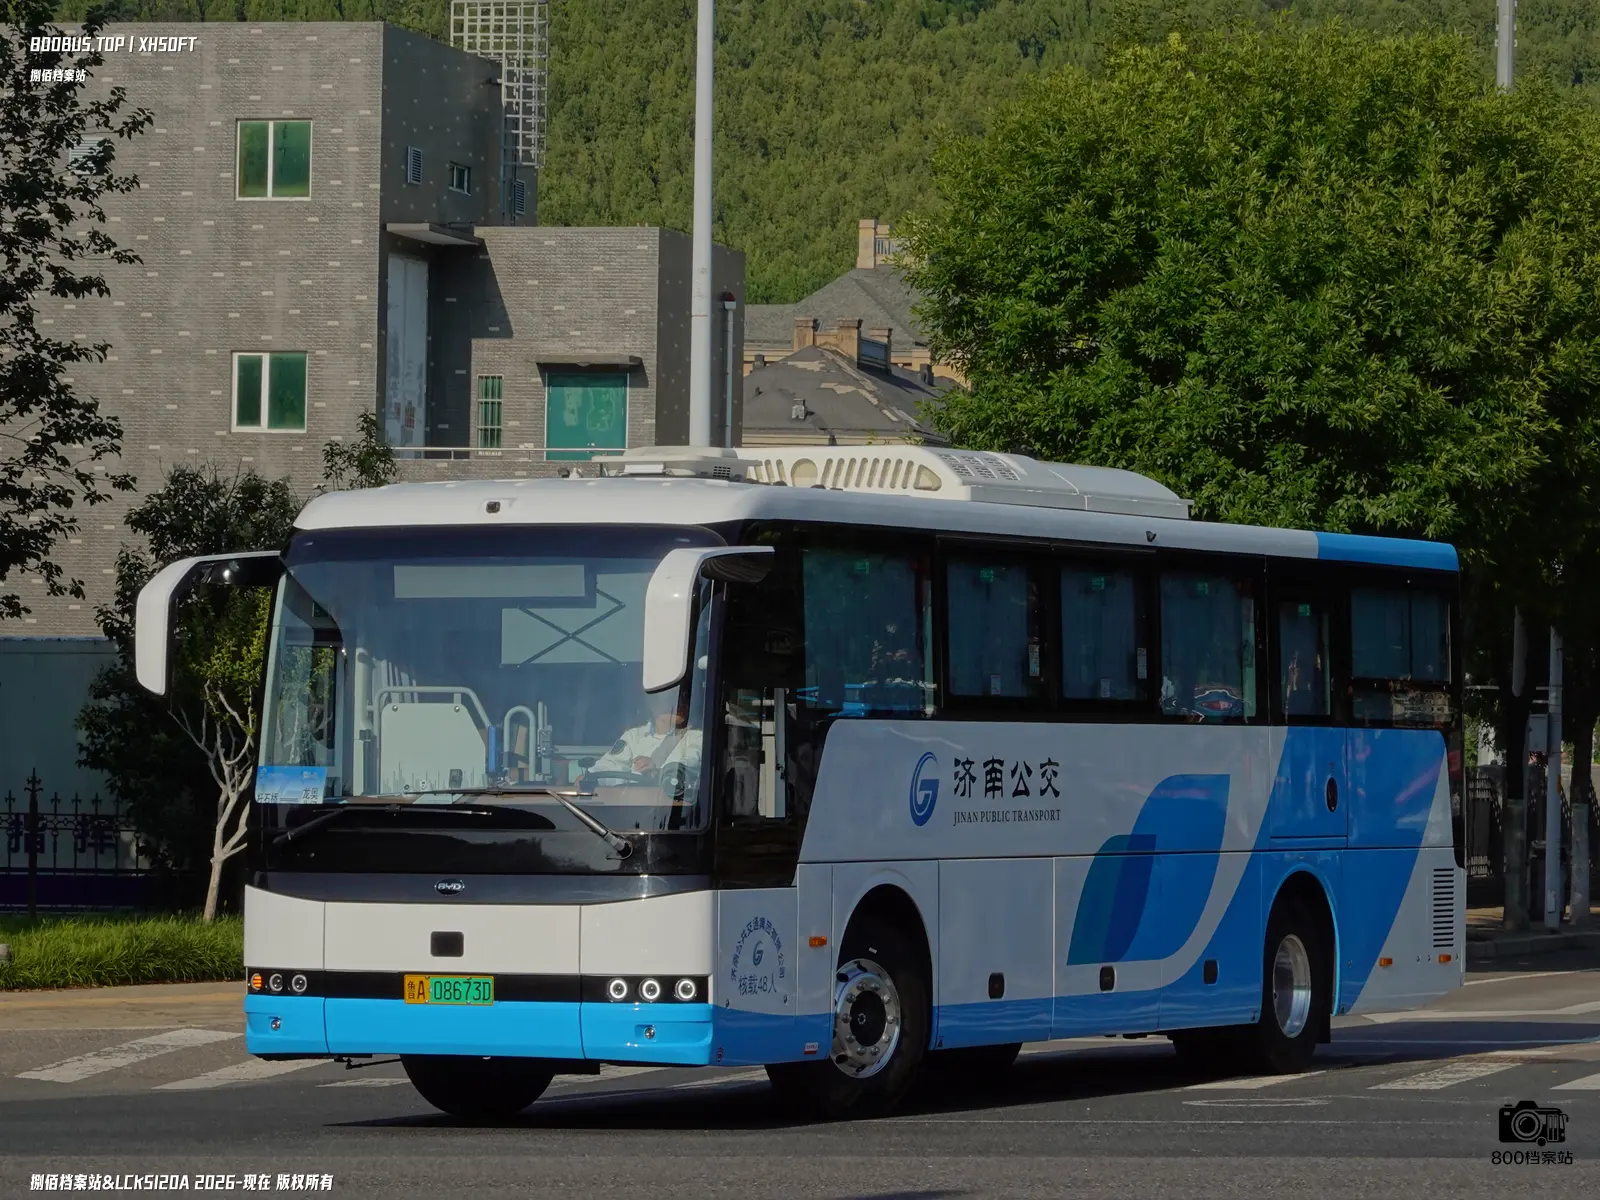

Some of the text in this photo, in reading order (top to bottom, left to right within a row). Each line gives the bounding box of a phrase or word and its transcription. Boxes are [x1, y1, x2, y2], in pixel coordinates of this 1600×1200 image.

[953, 756, 1061, 799] 济南公交
[953, 809, 1061, 826] JINAN PUBLIC TRANSPORT
[437, 882, 462, 891] BYD
[738, 972, 777, 996] 核载48人
